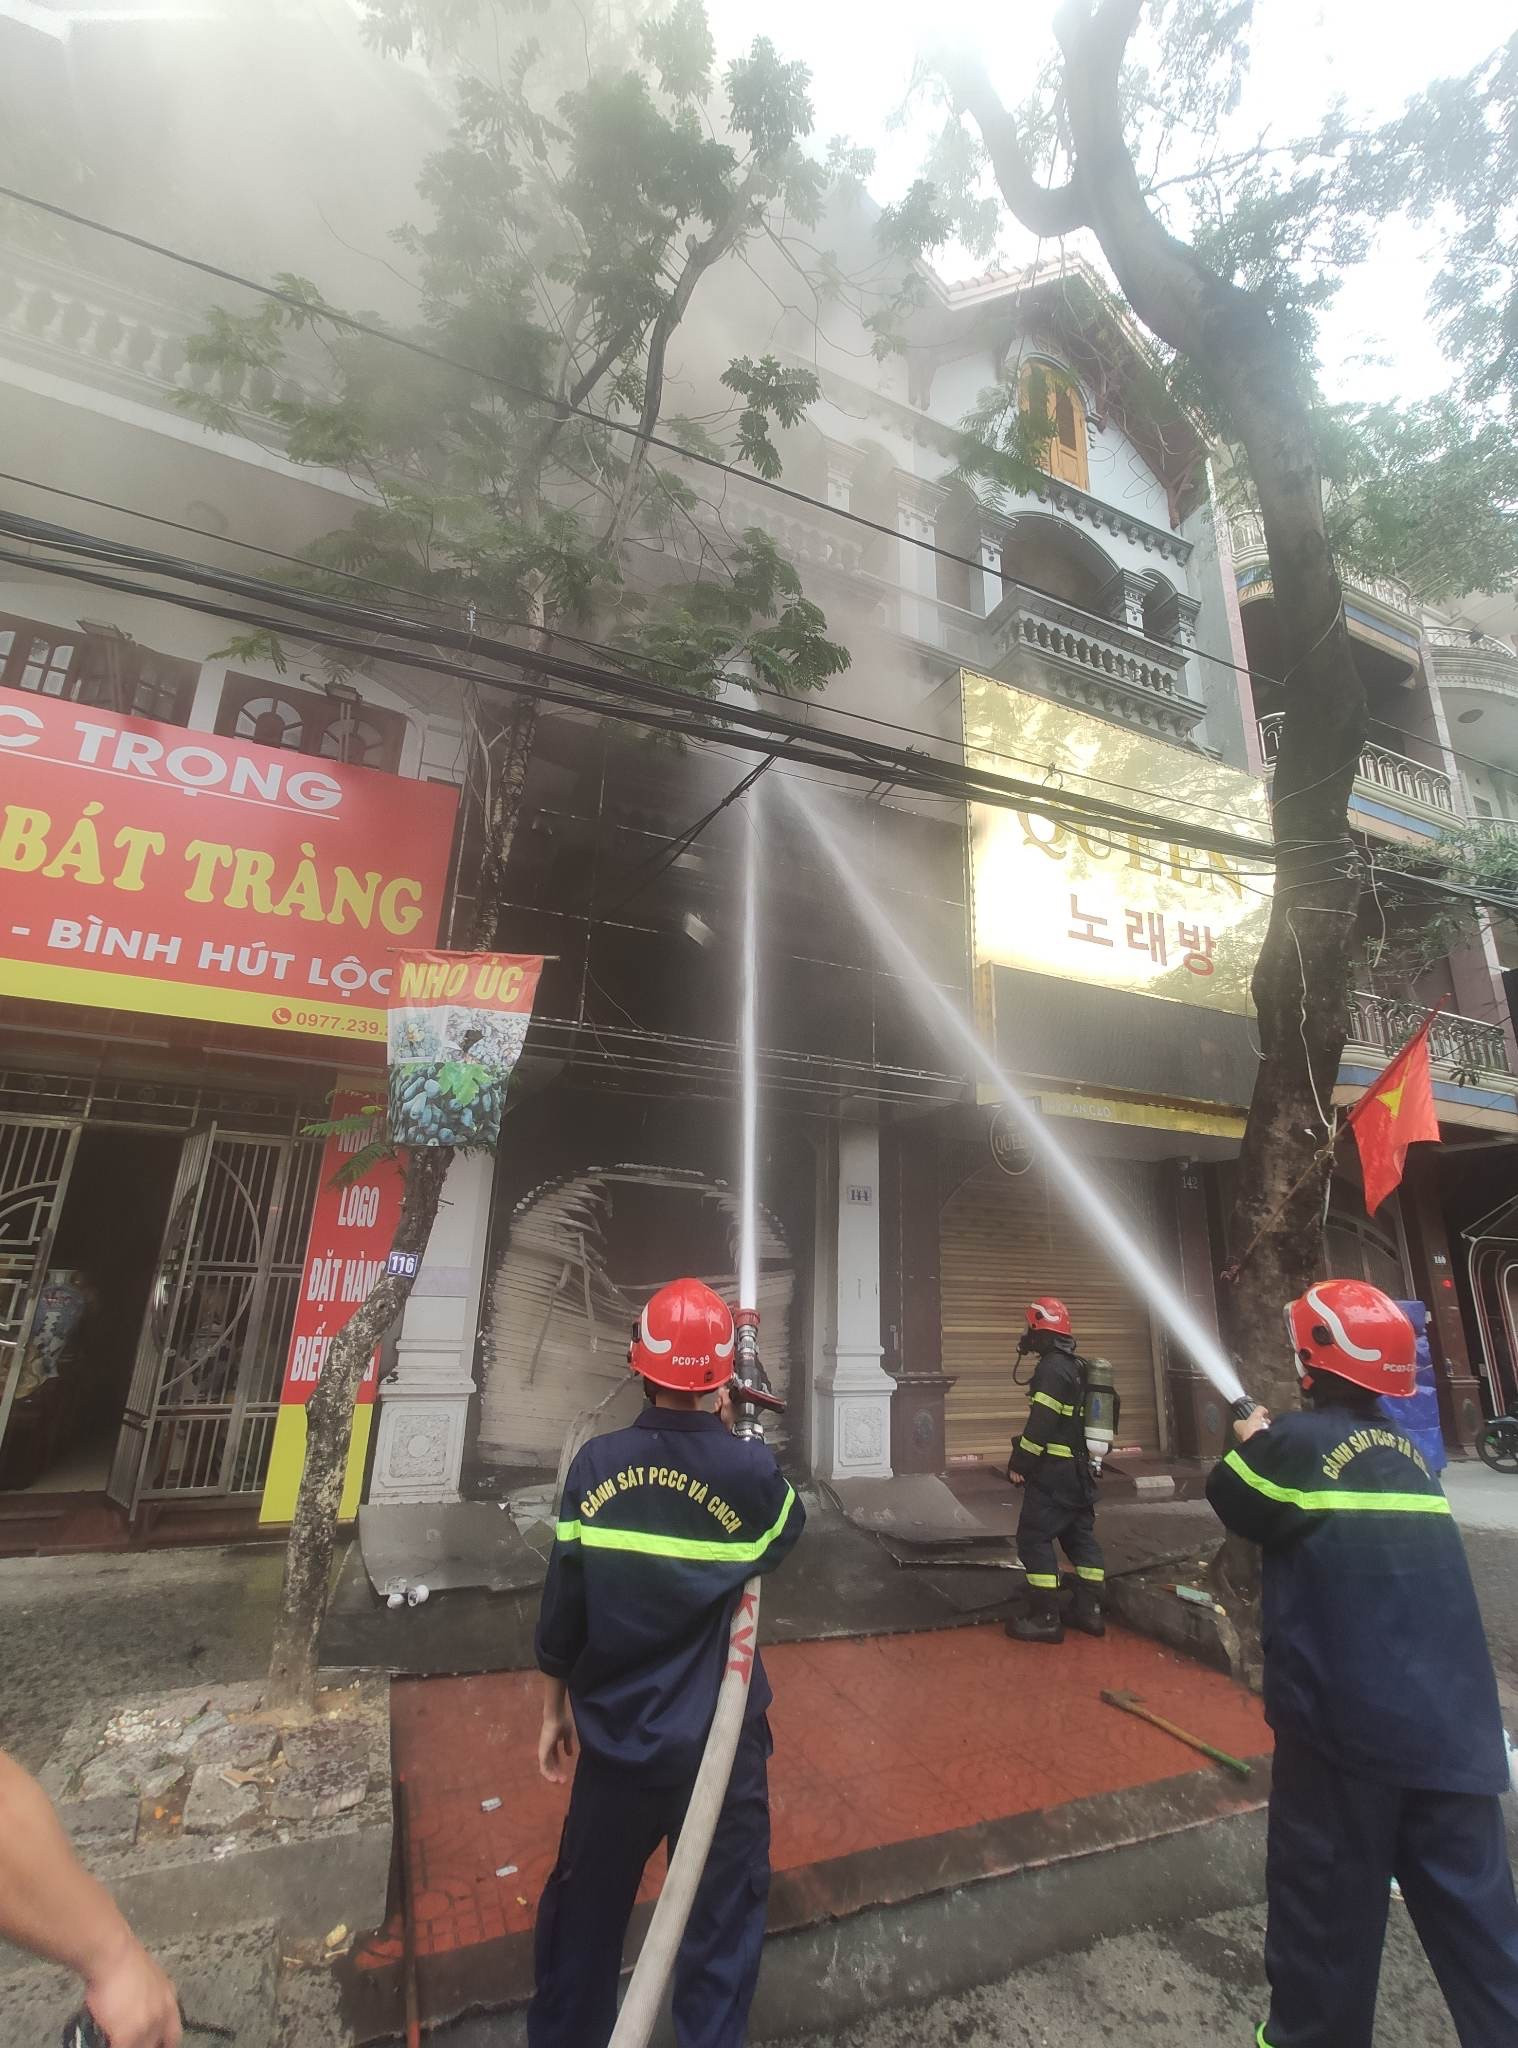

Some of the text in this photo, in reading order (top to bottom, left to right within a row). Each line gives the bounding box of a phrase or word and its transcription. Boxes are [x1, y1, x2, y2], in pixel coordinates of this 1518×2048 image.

[74, 720, 343, 811] TRỌNG
[0, 801, 424, 936] BÁT TRÀNG
[47, 914, 183, 965] BÌNH
[197, 941, 295, 981] HÚT
[307, 956, 393, 998] LỘC
[1068, 893, 1217, 977] 노래방
[400, 957, 524, 1003] NHO ÚC
[296, 1012, 388, 1037] 0977.239.
[337, 1185, 380, 1228] LOGO
[307, 1249, 342, 1312] ĐẶT
[392, 1255, 415, 1274] 116
[580, 1465, 743, 1535] CẢNH SÁT PCCC VÀ CNCH
